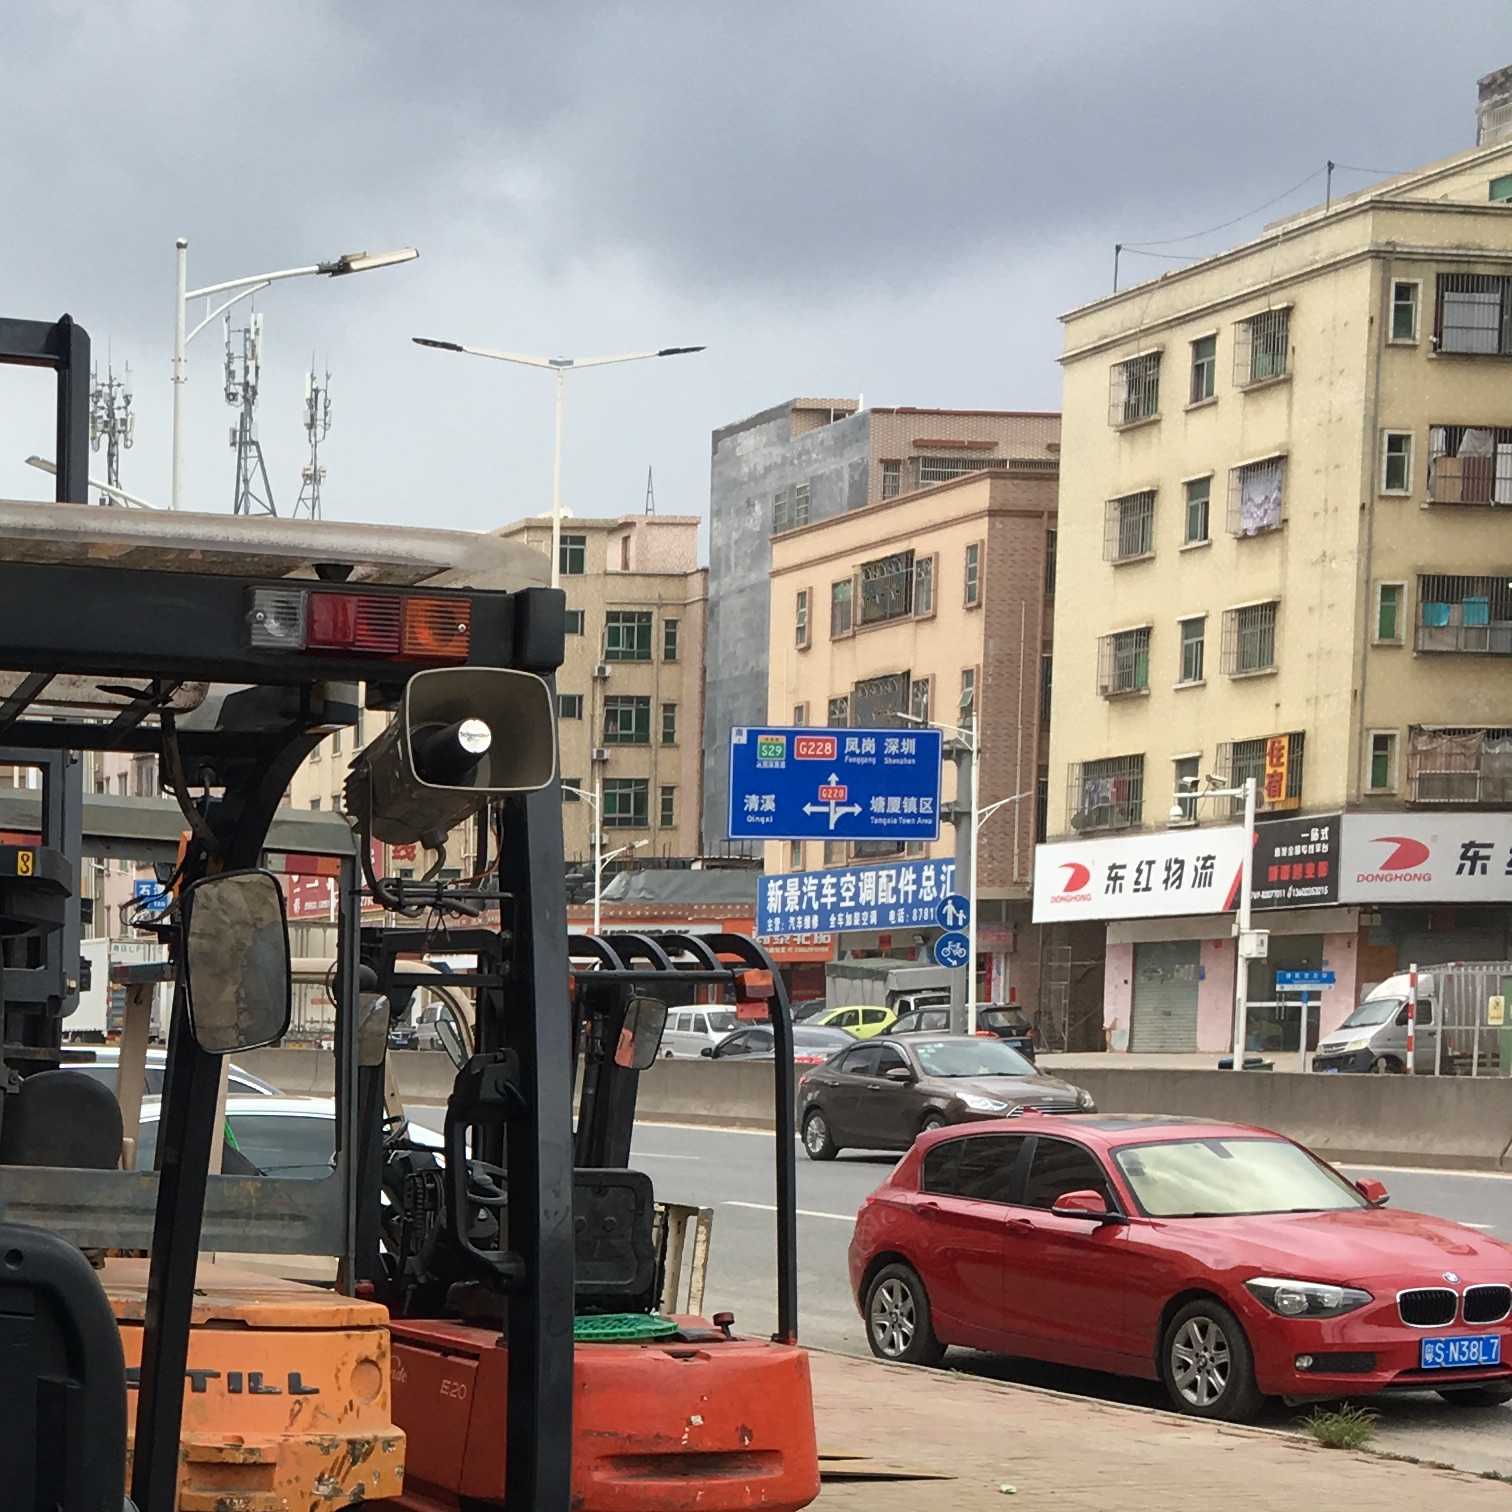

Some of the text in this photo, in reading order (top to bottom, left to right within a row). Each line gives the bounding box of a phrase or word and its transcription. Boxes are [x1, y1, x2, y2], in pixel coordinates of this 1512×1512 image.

[761, 744, 783, 757] S29
[799, 741, 833, 755] G228
[844, 737, 916, 756] 凤岗 深圳
[884, 756, 916, 765] Shenzhen
[1265, 739, 1285, 798] 住宿
[743, 793, 776, 812] 清溪
[869, 795, 933, 814] 塘厦镇区
[898, 816, 916, 825] Town
[916, 816, 933, 825] Area
[1455, 840, 1512, 876] 东
[1104, 854, 1216, 894] 东红物流
[1356, 872, 1432, 883] DONGHONG
[766, 863, 955, 914] 新景汽车空调配件总汇
[1050, 893, 1092, 904] DONGHONG
[439, 1379, 467, 1400] E20
